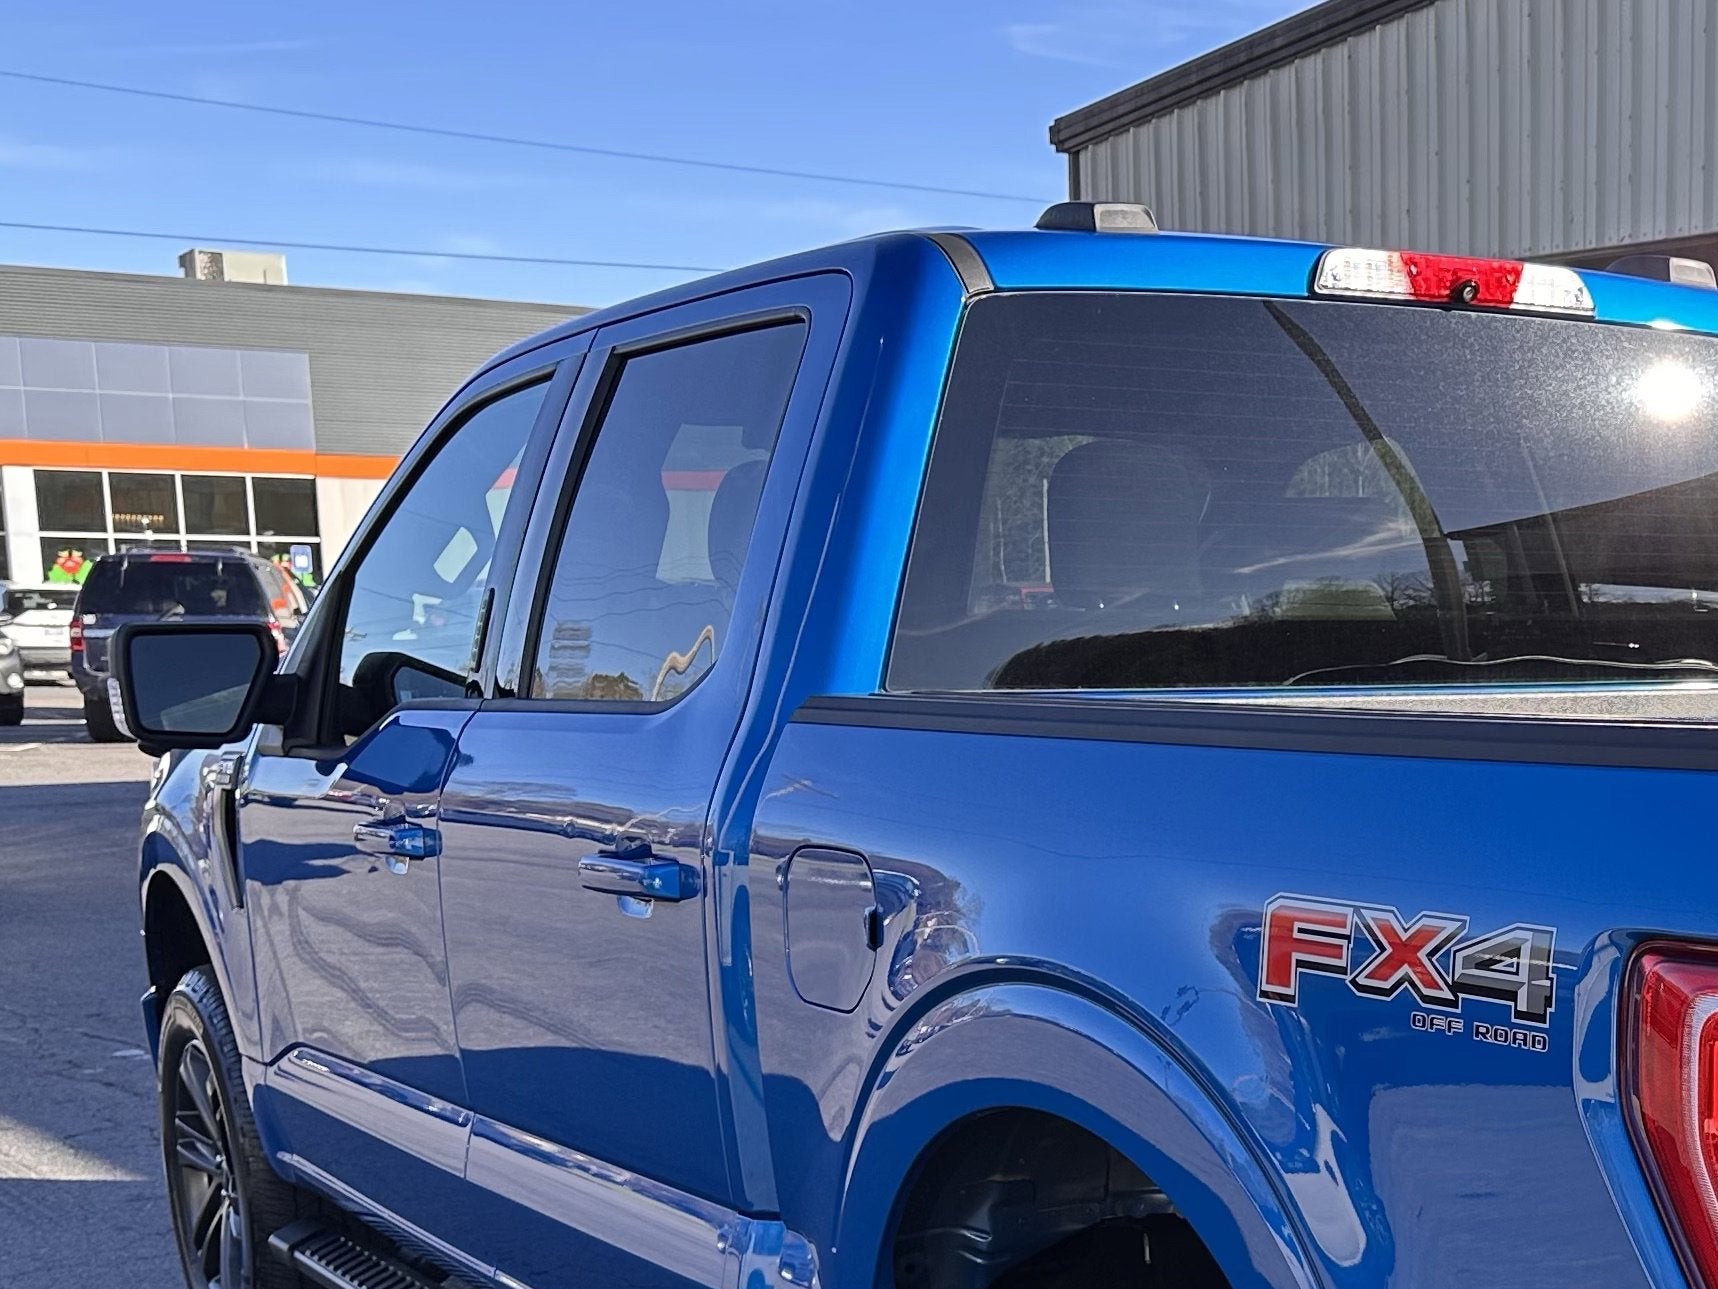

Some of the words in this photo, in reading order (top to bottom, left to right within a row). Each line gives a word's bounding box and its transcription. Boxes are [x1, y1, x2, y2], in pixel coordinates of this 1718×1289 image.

[1256, 892, 1557, 1027] FX4
[1410, 1011, 1464, 1034] OFF
[1473, 1022, 1549, 1052] ROAD
